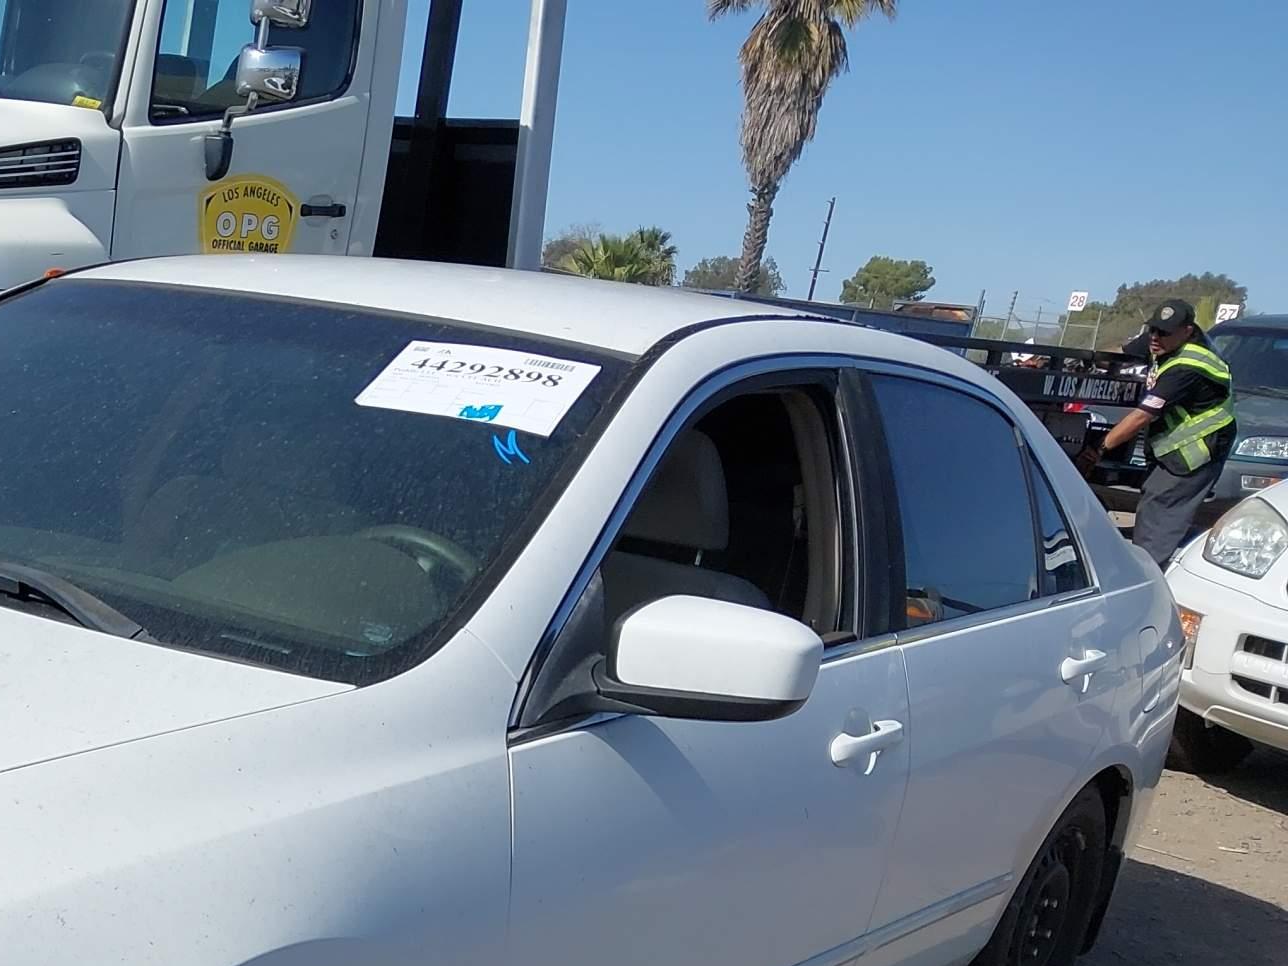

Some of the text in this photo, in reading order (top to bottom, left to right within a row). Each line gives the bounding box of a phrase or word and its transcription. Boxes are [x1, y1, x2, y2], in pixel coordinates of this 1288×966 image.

[222, 185, 281, 207] LOS ANGELES
[215, 211, 281, 241] OPG
[211, 239, 280, 254] OFFICIAL GARAGE
[1070, 295, 1086, 308] 28
[1218, 308, 1237, 320] 27
[409, 357, 564, 388] 44292898
[1043, 375, 1055, 396] W.
[1057, 375, 1078, 397] LOS
[1123, 381, 1137, 401] CA
